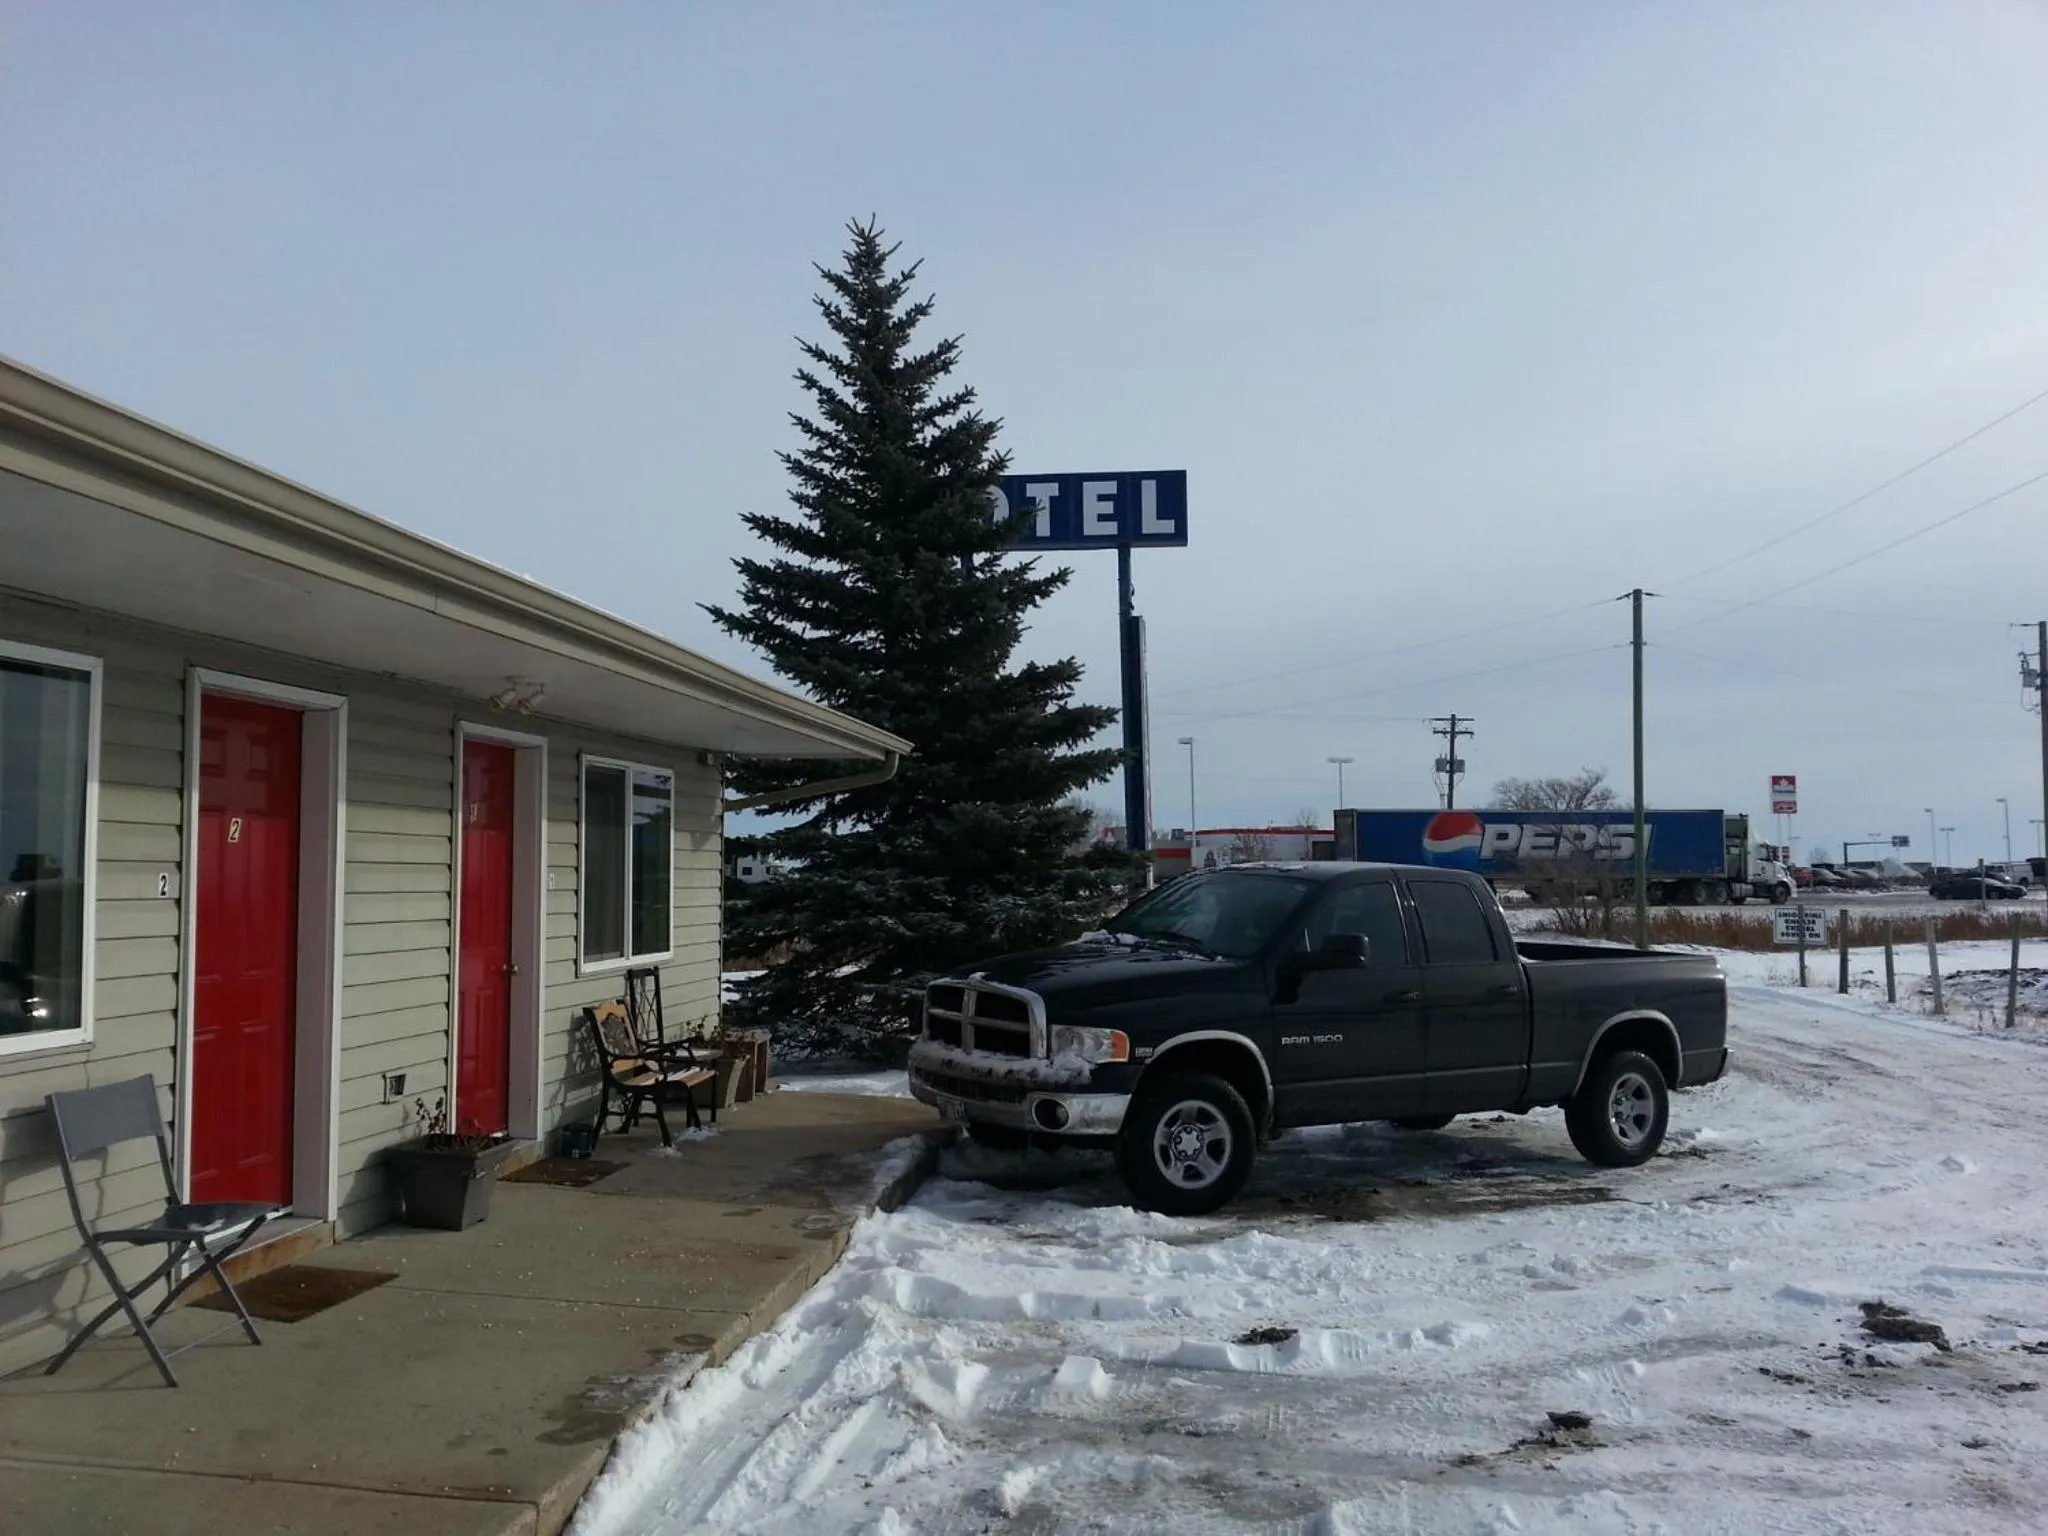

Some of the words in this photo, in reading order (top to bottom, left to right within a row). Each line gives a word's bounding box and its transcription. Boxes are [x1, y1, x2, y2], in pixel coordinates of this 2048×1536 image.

[1480, 823, 1653, 861] PEPSI
[1281, 1036, 1310, 1045] RAM
[1313, 1034, 1343, 1043] 1500
